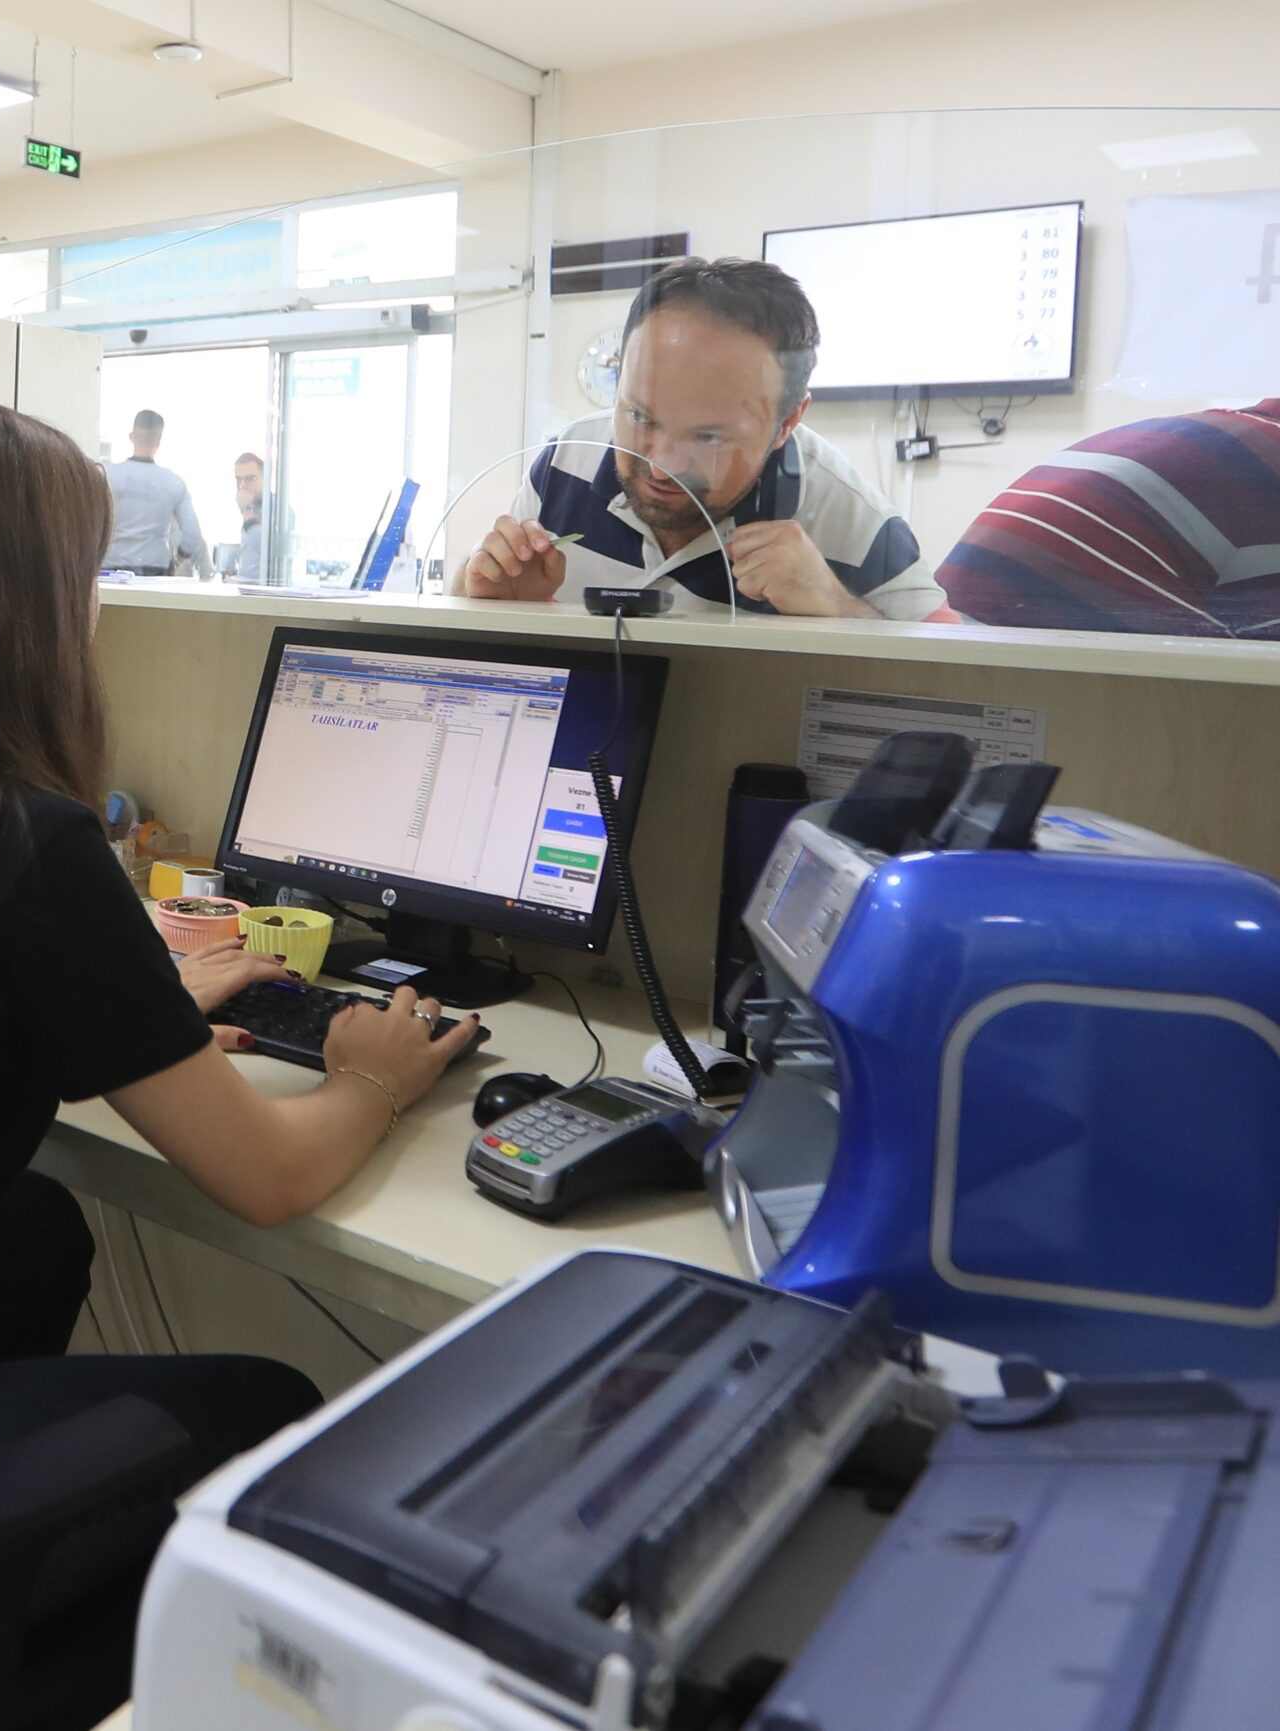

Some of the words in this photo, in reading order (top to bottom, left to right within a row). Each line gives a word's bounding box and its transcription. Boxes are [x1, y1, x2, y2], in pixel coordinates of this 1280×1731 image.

[1020, 230, 1028, 240] 4
[1042, 227, 1059, 238] 81
[1042, 247, 1059, 258] 80
[1019, 270, 1027, 281] 2
[1041, 268, 1058, 279] 79
[1040, 288, 1057, 299] 78
[1039, 308, 1056, 319] 77
[311, 713, 379, 731] TAHSİLATLAR
